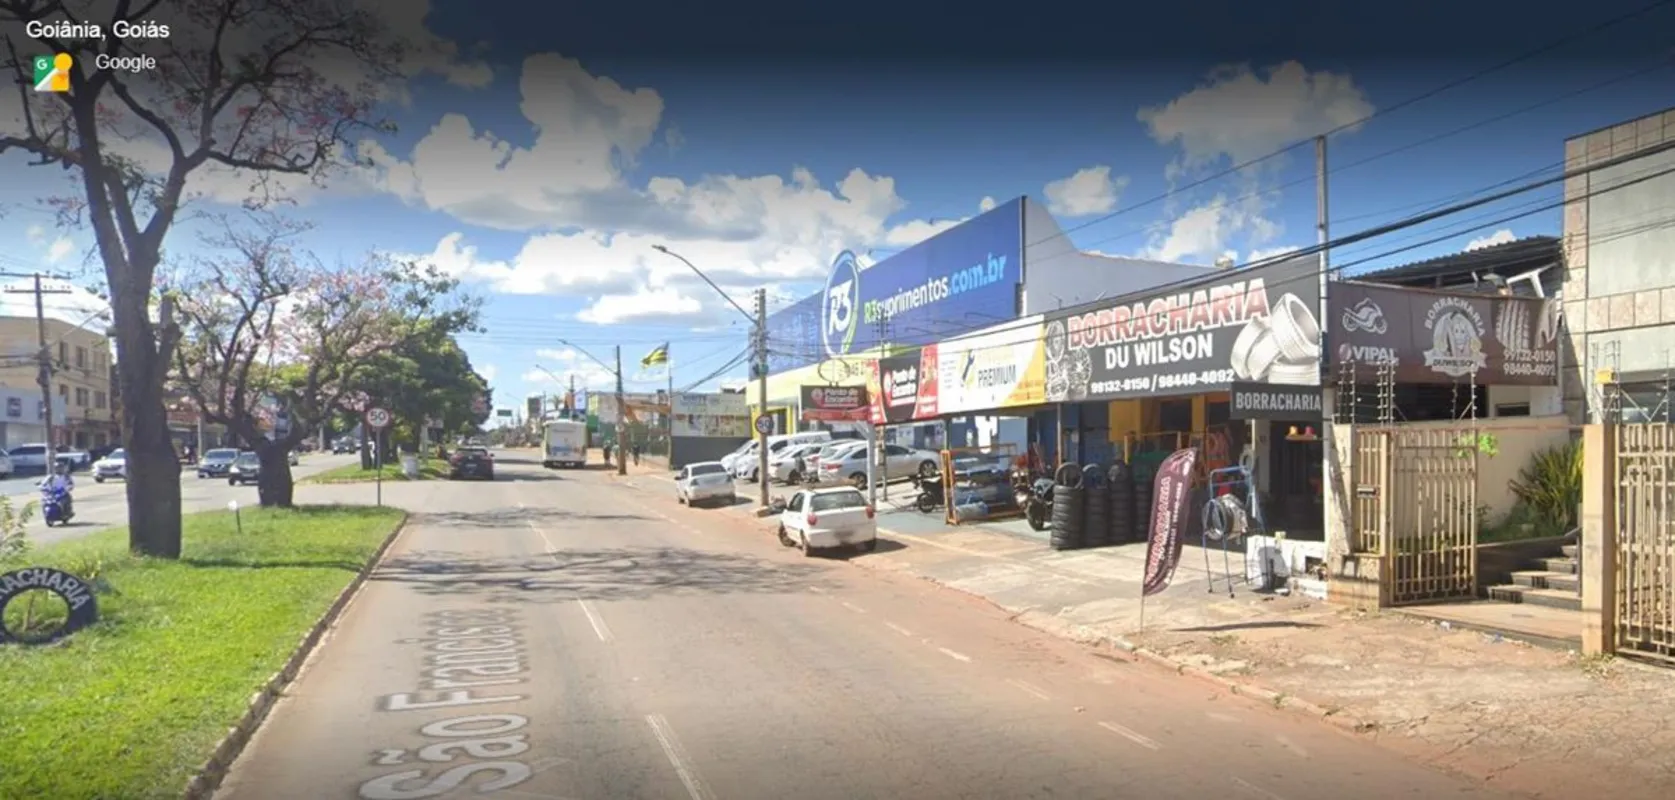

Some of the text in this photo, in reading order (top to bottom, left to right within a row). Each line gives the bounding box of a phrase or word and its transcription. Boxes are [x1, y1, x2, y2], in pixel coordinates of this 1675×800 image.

[1067, 278, 1270, 349] BORRACHARIA
[1424, 296, 1486, 338] BORRACHARIA
[1105, 333, 1213, 369] DU WILSON
[1352, 345, 1398, 364] VIPAL
[978, 364, 1016, 388] PREMIUM
[1159, 369, 1234, 388] 98440-4092
[1235, 391, 1322, 411] BORRACHARIA
[370, 411, 386, 422] 50
